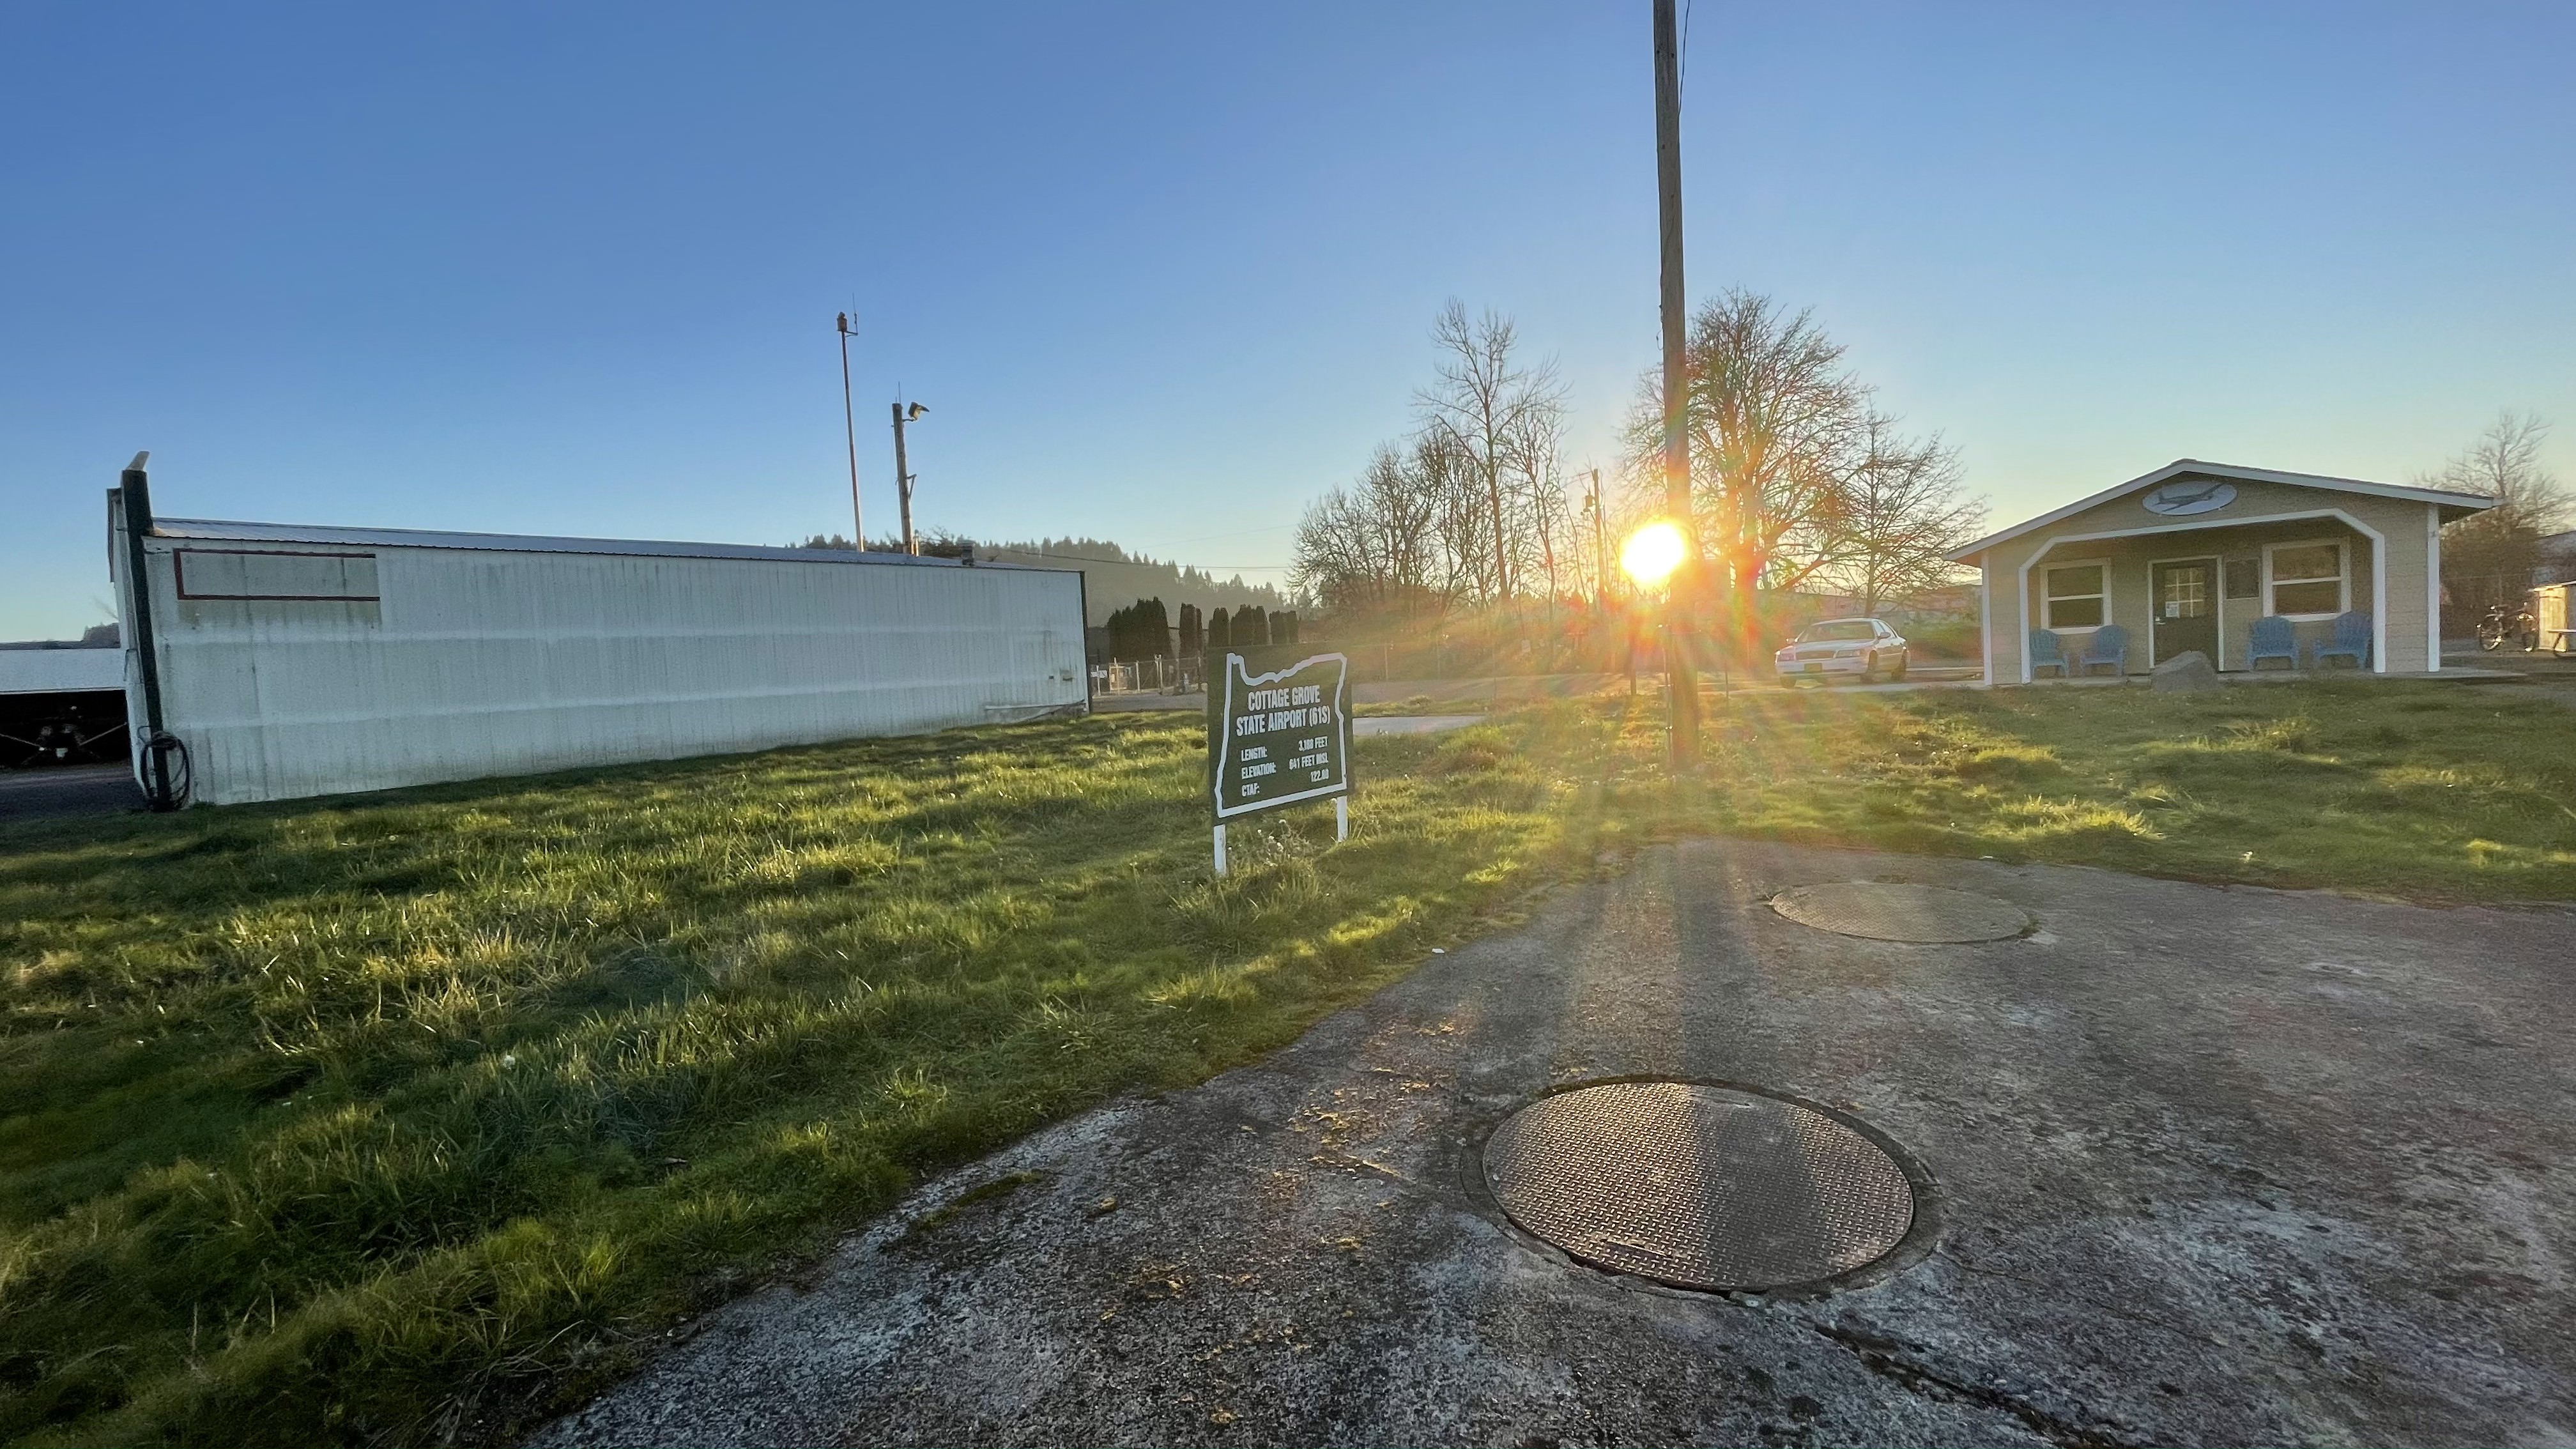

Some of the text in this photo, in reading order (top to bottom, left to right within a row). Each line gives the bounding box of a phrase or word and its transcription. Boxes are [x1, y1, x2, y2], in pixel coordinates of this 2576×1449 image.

[1248, 685, 1321, 711] COTTAGE GROVE
[1236, 705, 1330, 736] STATE AIRPORT (61S)
[1241, 746, 1268, 762] LENGTH:
[1315, 736, 1328, 748] FEET
[1241, 762, 1276, 779] ELEVATION:
[1301, 755, 1315, 768] FEET
[1241, 783, 1261, 797] CTAF:
